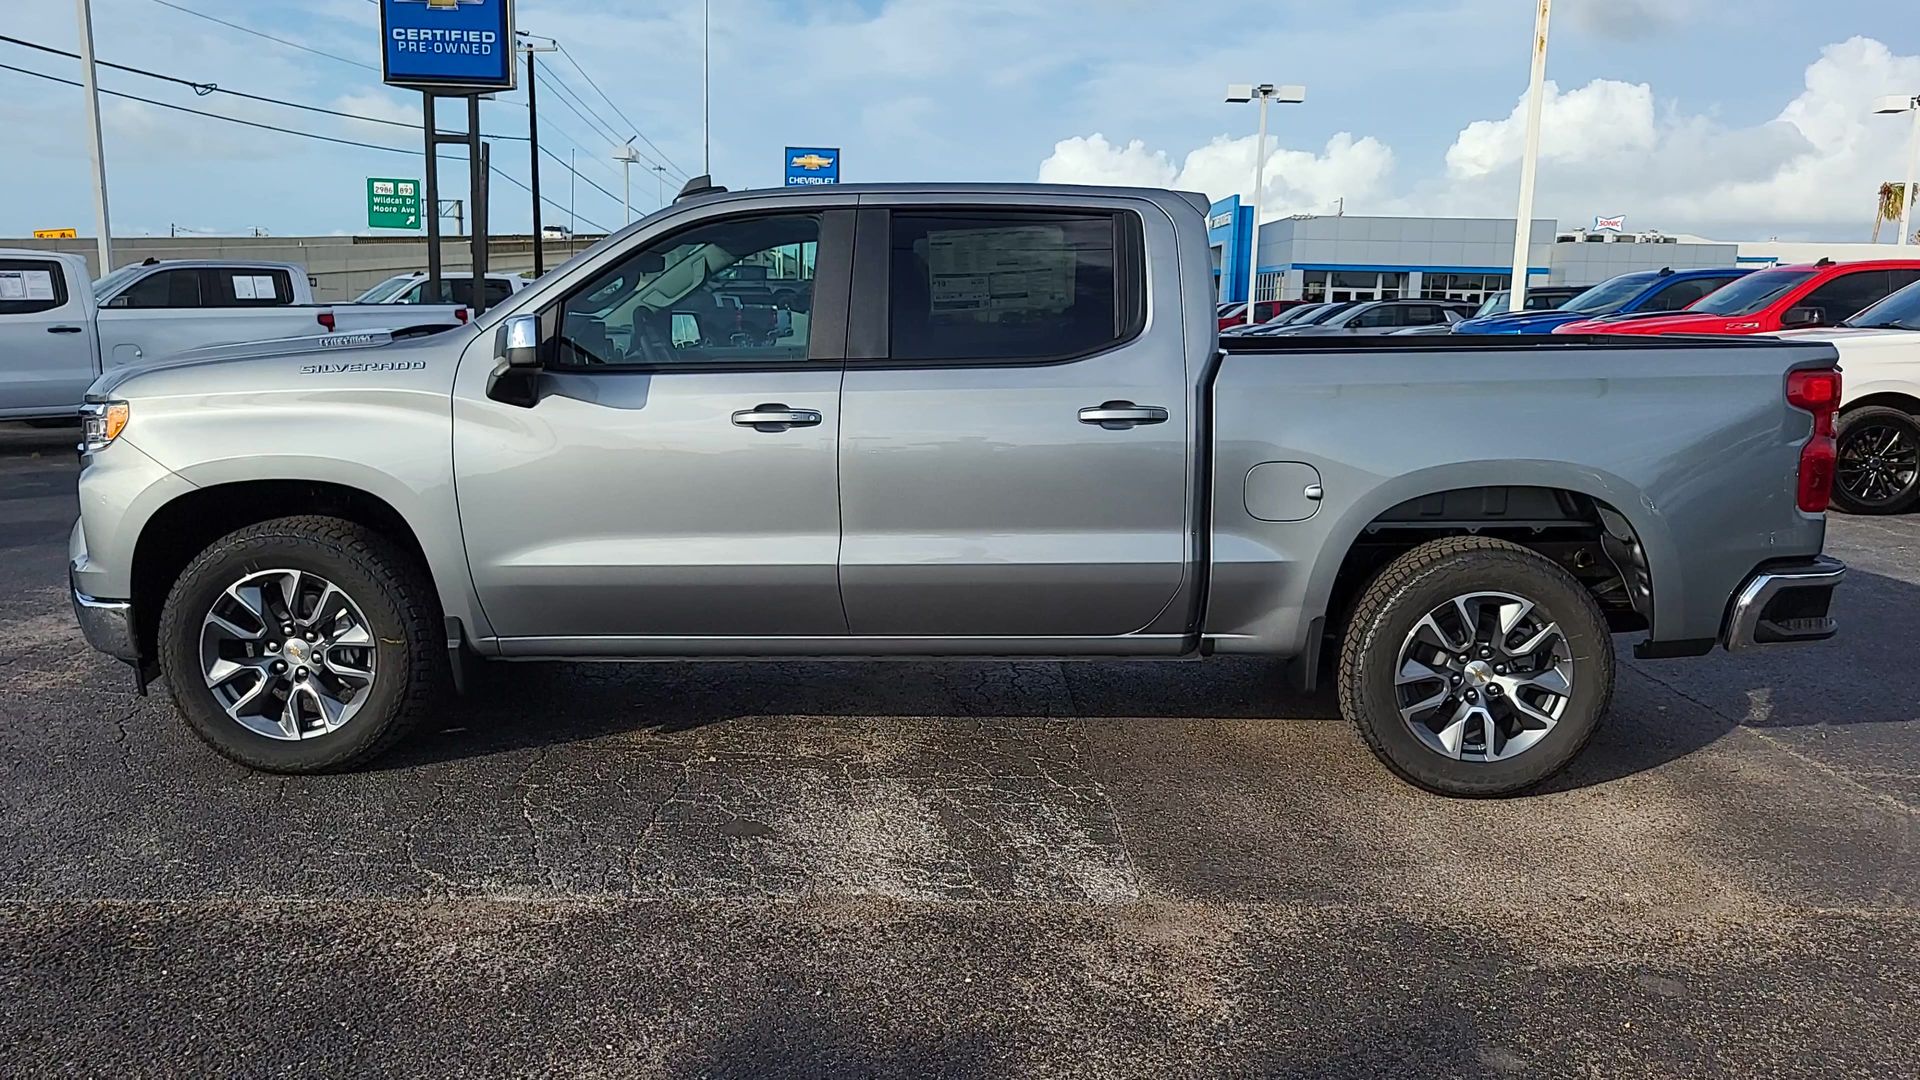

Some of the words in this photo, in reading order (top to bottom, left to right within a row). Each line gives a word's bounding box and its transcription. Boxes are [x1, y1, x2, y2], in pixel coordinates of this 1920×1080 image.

[392, 28, 496, 43] CERTIFIED
[398, 41, 491, 55] PRE-OWNED
[789, 176, 835, 184] CHEVROLET
[375, 185, 393, 194] 2986
[399, 187, 413, 195] 893
[373, 196, 403, 205] Wildcat
[405, 197, 415, 205] Dr
[373, 205, 398, 213] Moore
[401, 206, 415, 214] Ave
[300, 360, 426, 375] SILVERADO
